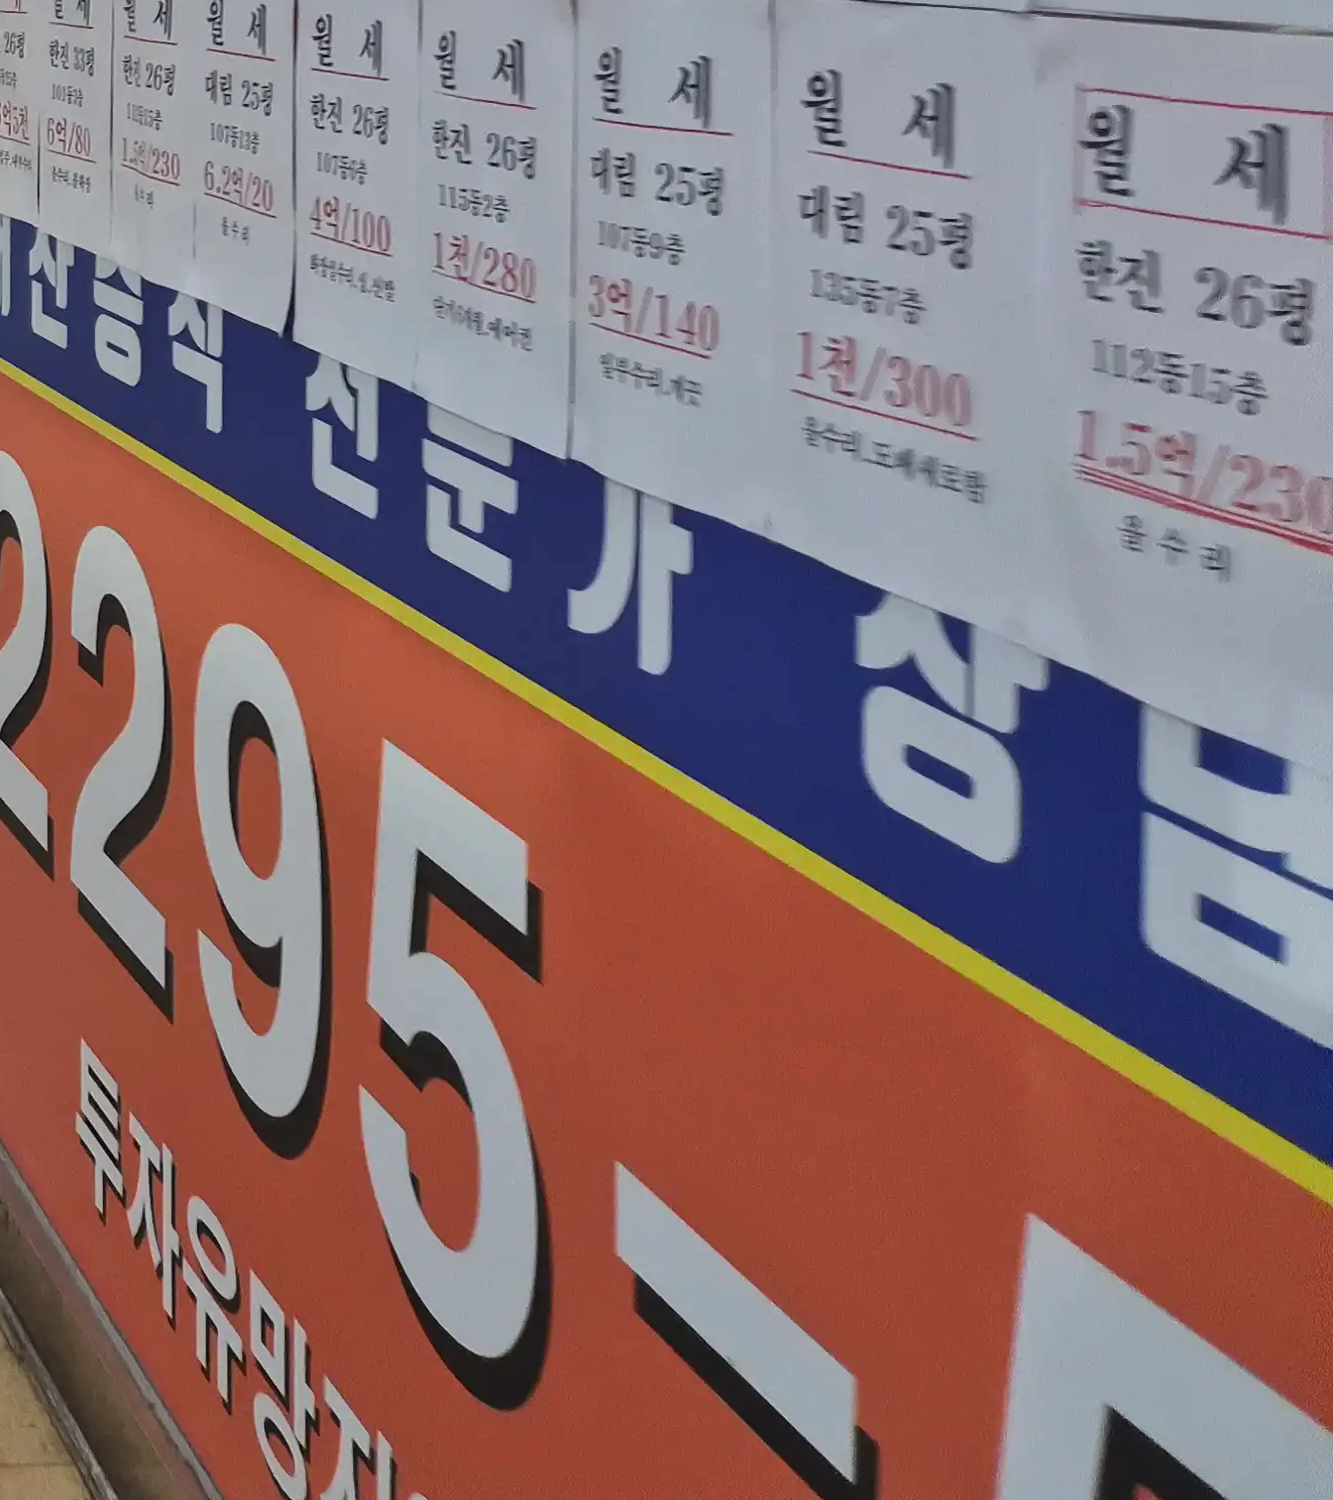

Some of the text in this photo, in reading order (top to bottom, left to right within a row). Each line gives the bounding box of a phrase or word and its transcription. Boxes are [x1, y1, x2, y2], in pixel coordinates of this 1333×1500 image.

[4, 31, 25, 60] 26평
[49, 39, 69, 70] 한진
[145, 62, 177, 96] 26평
[204, 69, 274, 117] 대림 25평
[309, 93, 390, 146] 한진 26평
[46, 116, 92, 157] 6억/80
[432, 118, 538, 180] 한진 26평
[589, 147, 725, 219] 대림 25평
[309, 195, 393, 252] 4억/100
[798, 184, 976, 271] 대림 25평
[432, 231, 537, 299] 1천/280
[1074, 238, 1317, 348] 한진 26평
[587, 273, 722, 353] 3억/140
[796, 329, 974, 428] 1천/300
[1090, 338, 1270, 417] 112동15층
[1074, 407, 1333, 534] 1.5억/230
[75, 1037, 428, 1500] 투자유망지
